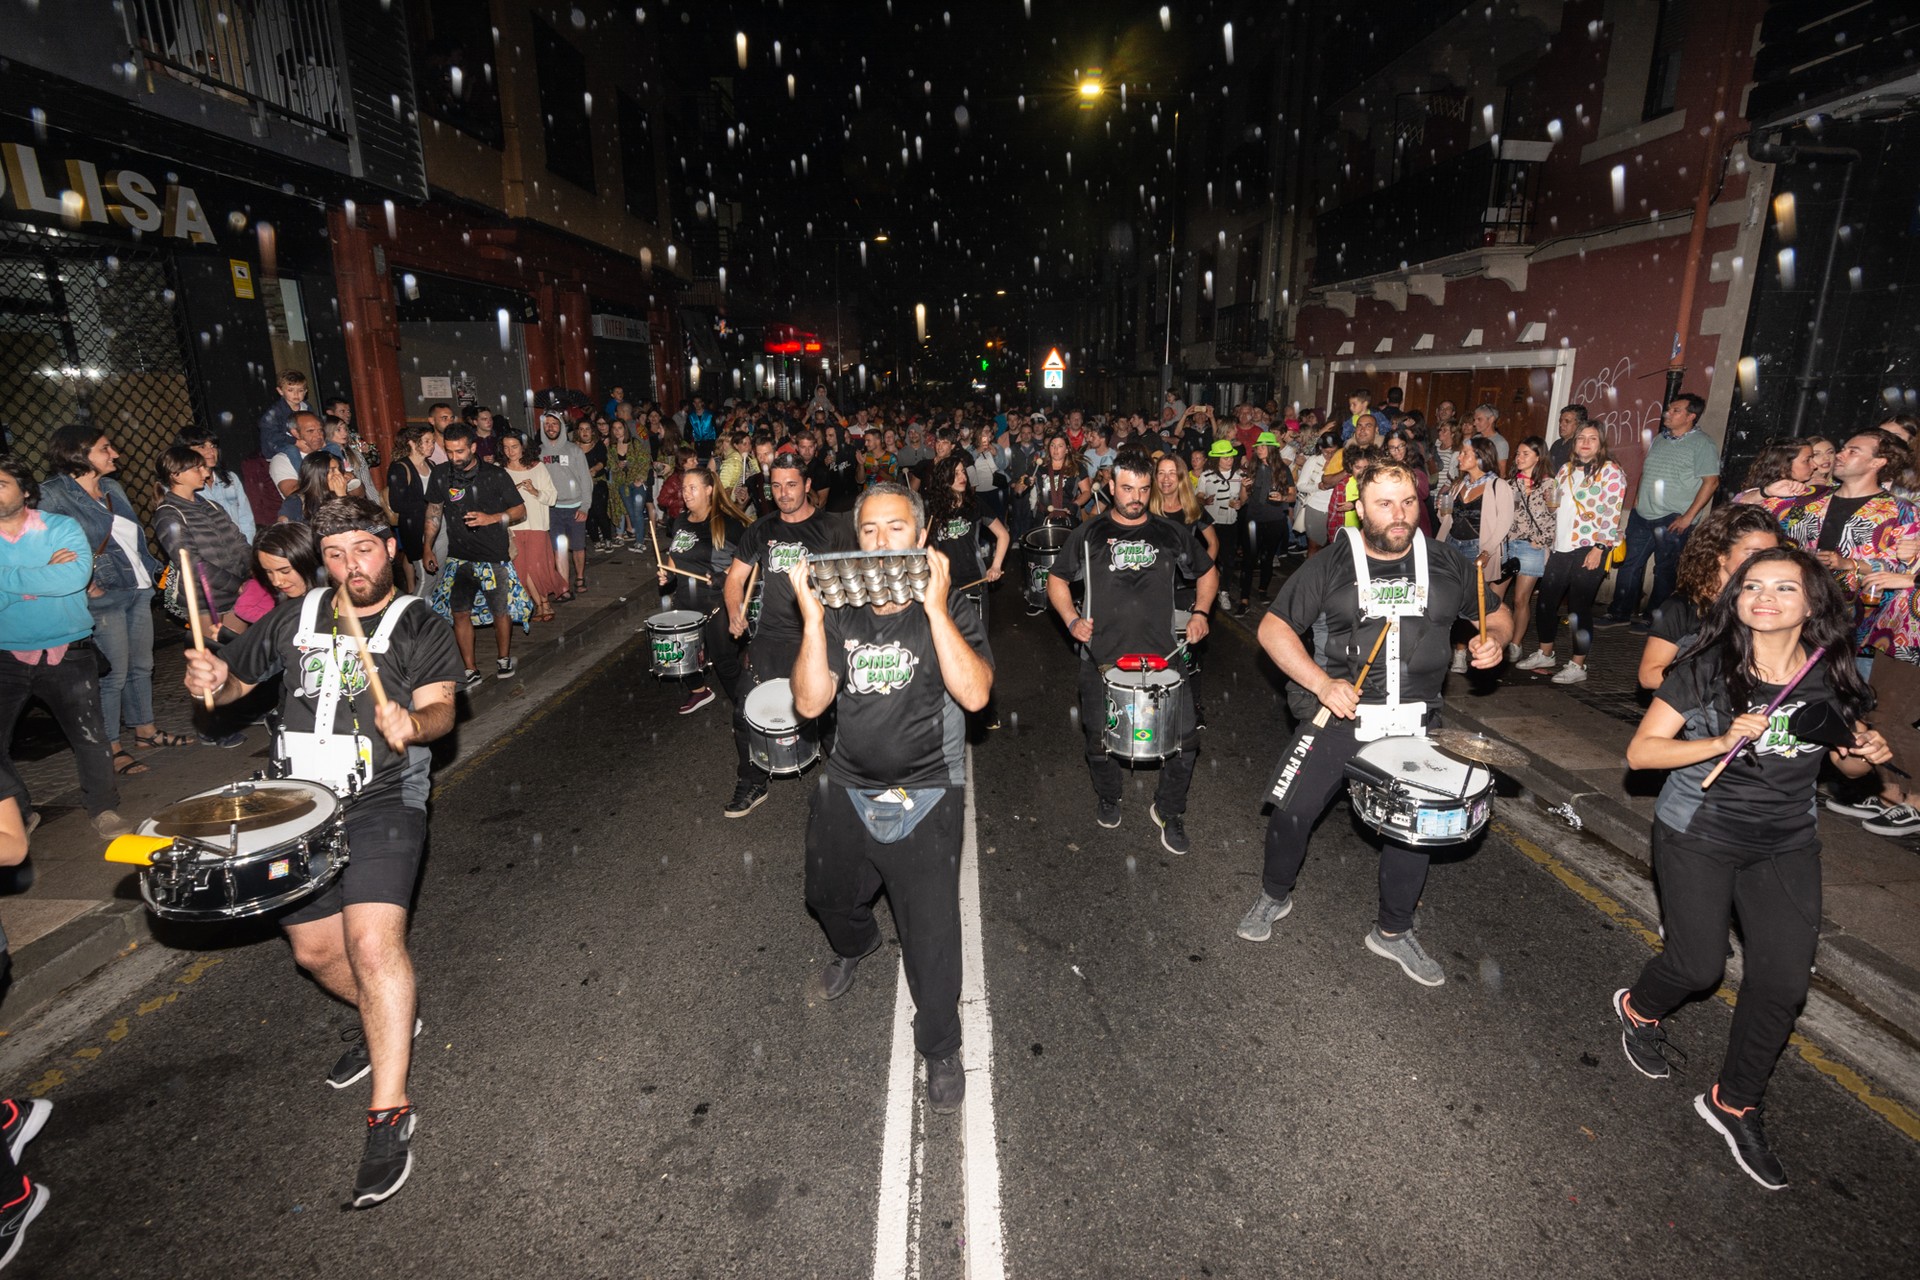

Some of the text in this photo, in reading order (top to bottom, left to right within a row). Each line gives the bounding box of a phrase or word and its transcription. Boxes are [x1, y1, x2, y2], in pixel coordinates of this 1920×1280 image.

[0, 142, 217, 245] LISA
[1594, 401, 1663, 445] RRIA
[856, 652, 901, 670] DINBI
[866, 668, 911, 684] BANDA
[1271, 734, 1315, 801] VIC FIRTH
